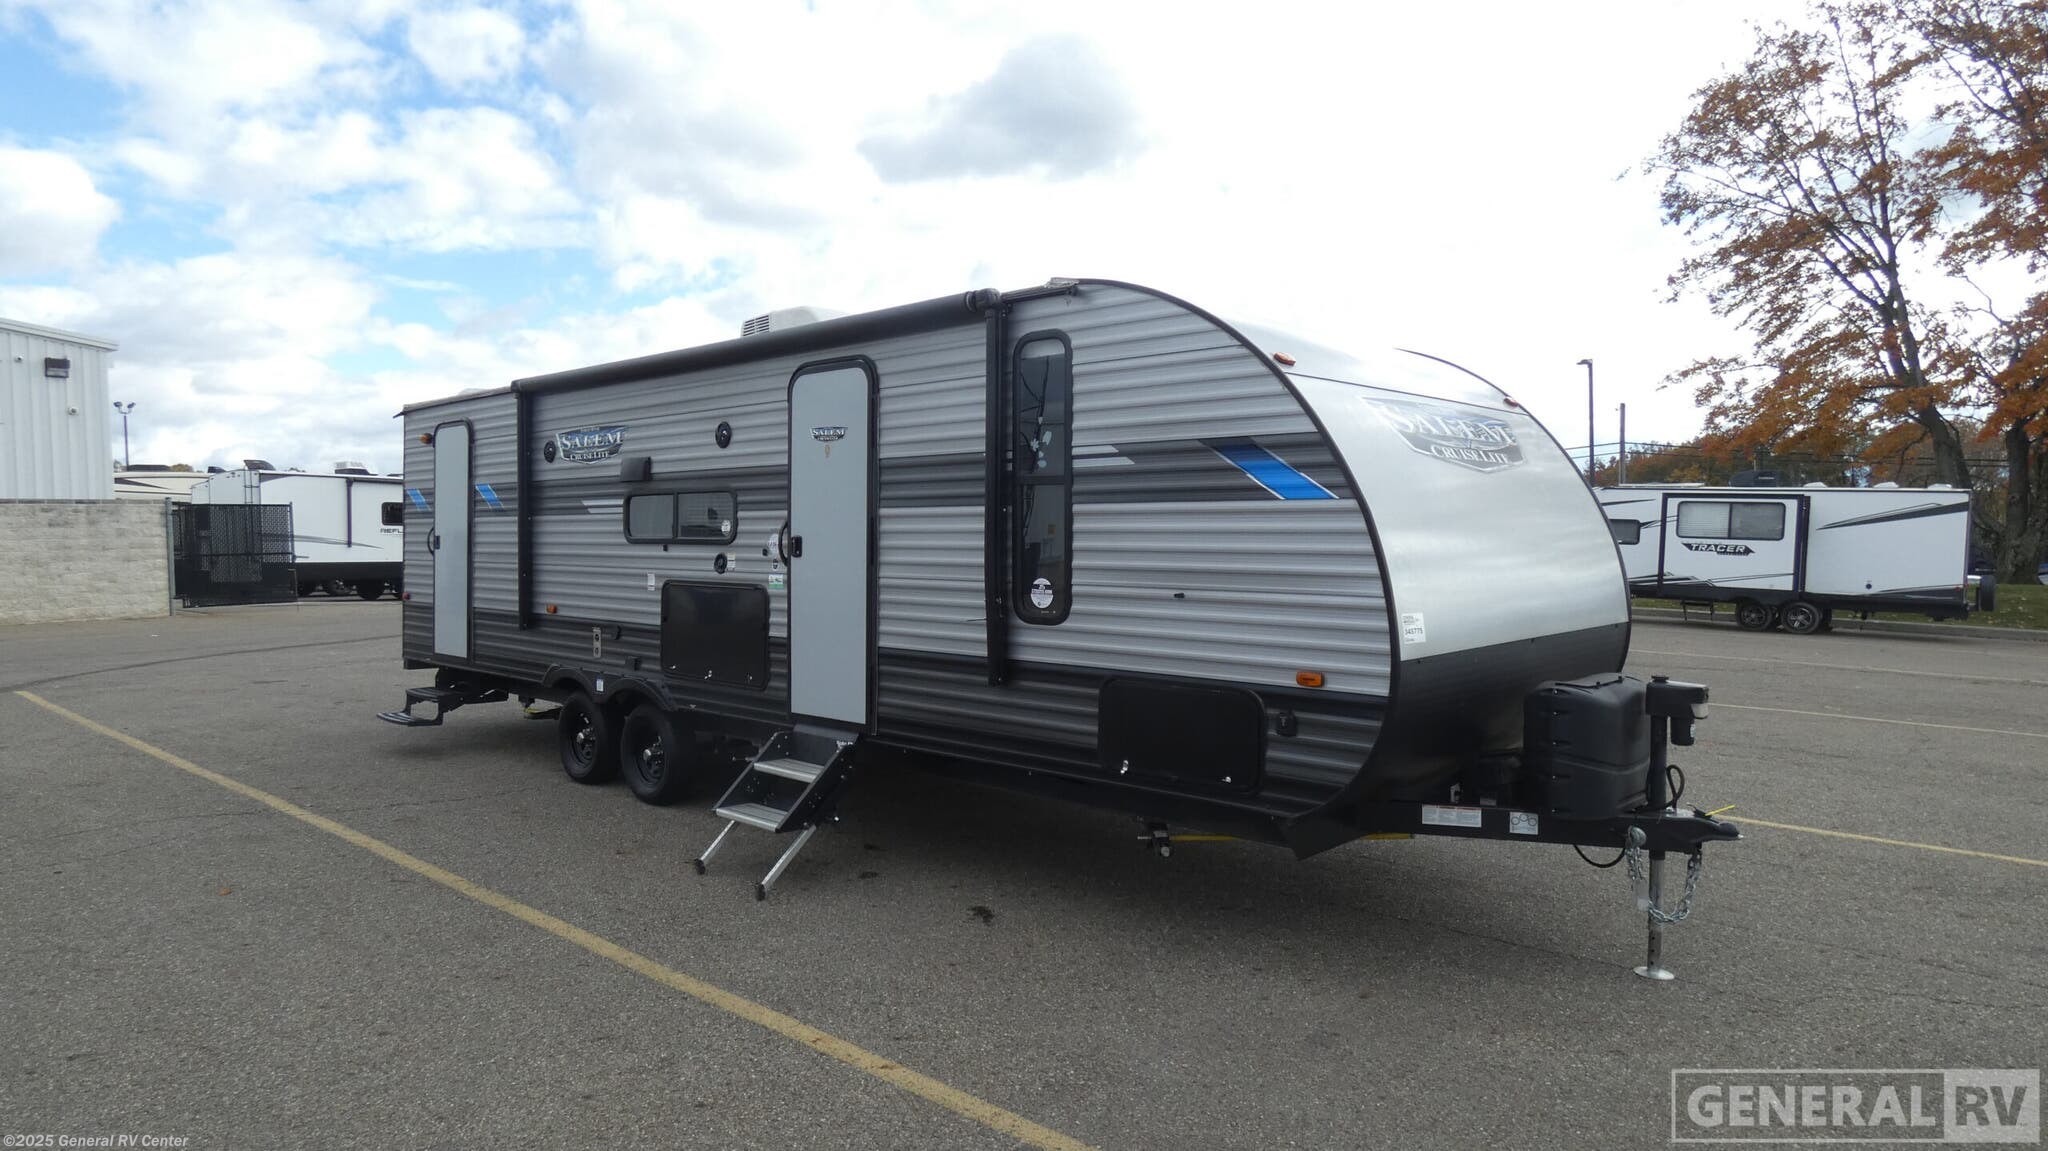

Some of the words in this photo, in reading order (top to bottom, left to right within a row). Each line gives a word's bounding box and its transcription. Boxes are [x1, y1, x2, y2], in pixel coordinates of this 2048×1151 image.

[1379, 404, 1518, 446] SALEM
[561, 431, 623, 450] SALEM
[1690, 543, 1747, 553] TRACER
